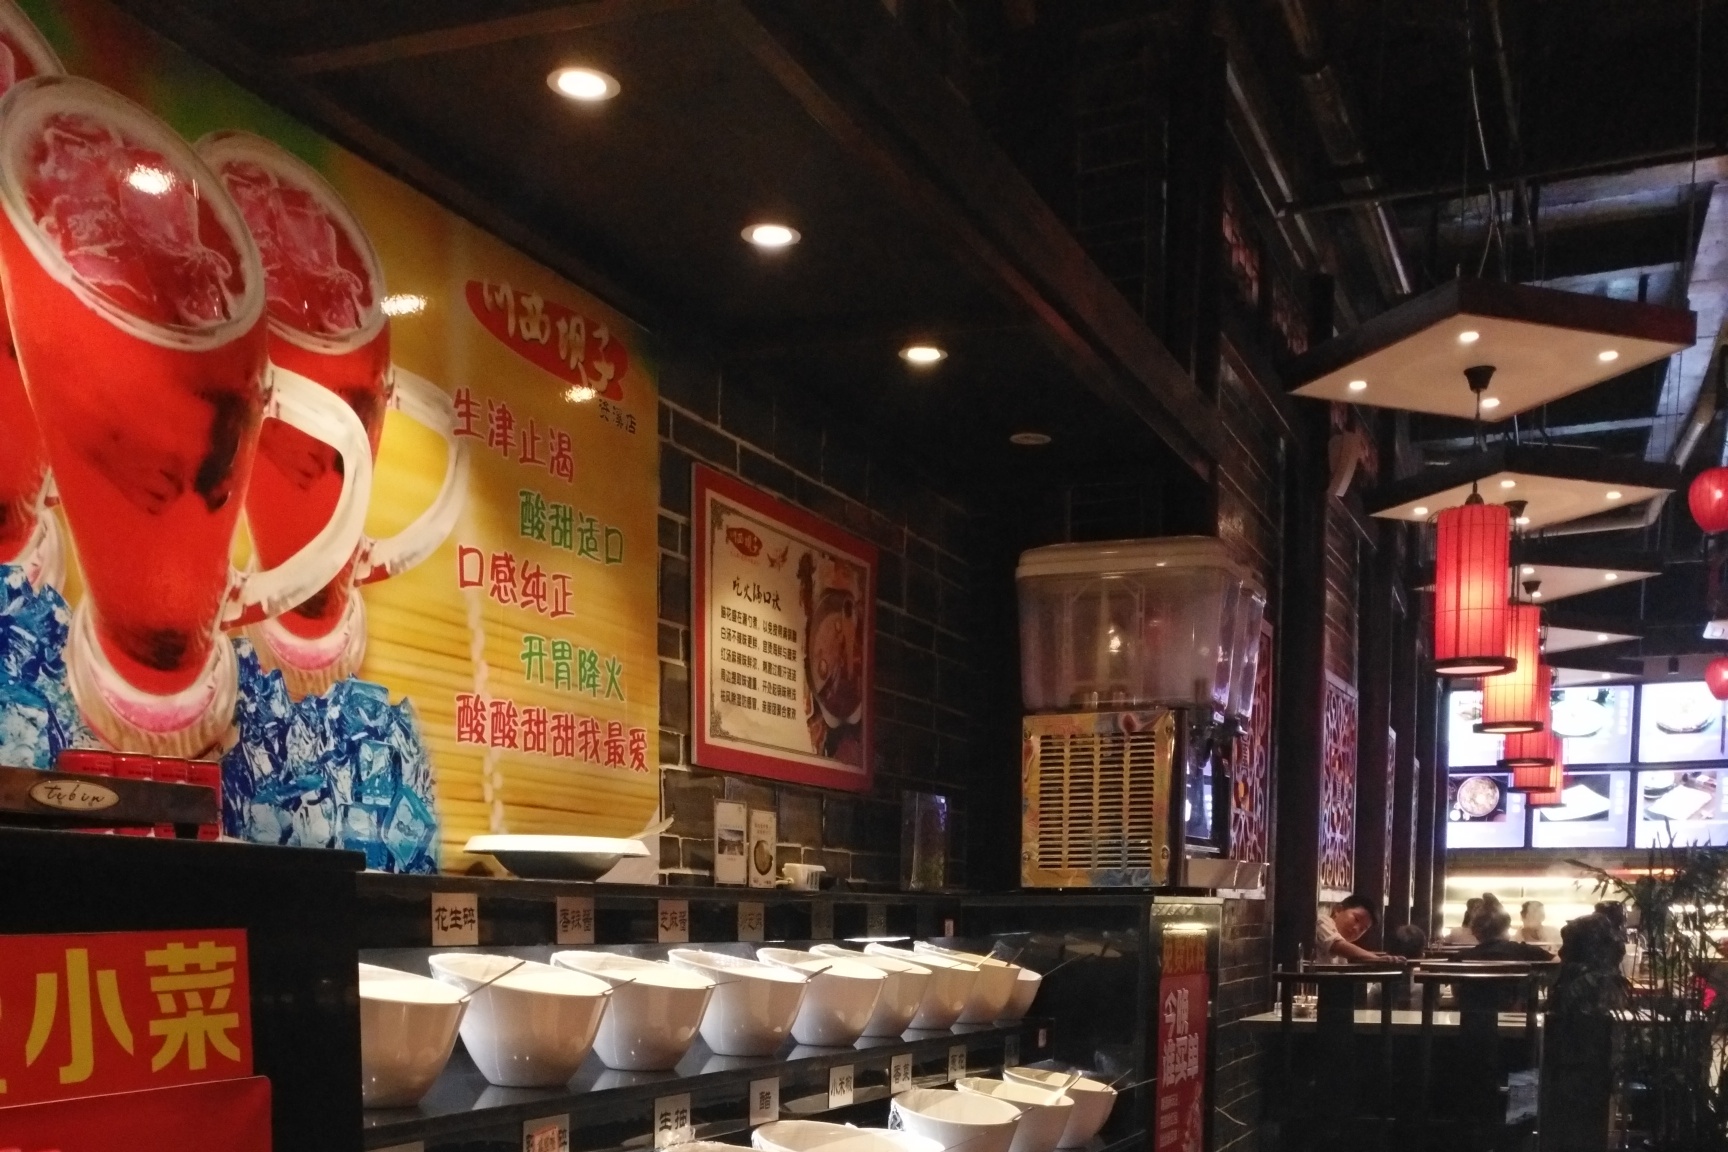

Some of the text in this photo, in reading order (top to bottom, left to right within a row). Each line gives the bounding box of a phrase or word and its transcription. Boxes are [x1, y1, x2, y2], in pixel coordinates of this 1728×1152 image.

[453, 387, 575, 484] 生津止渴
[518, 489, 624, 565] 酸甜适口
[458, 544, 575, 618] 口感纯正
[732, 575, 782, 612] 吃火锅口诀
[520, 635, 625, 702] 开胃降火
[455, 693, 649, 773] 酸酸甜甜我最爱
[434, 906, 476, 932] 花生碎
[660, 911, 687, 932] 芝麻酱
[0, 941, 241, 1094] 小菜
[1163, 987, 1189, 1039] 今晚
[893, 1063, 910, 1084] 香菜
[658, 1107, 688, 1133] 生抽
